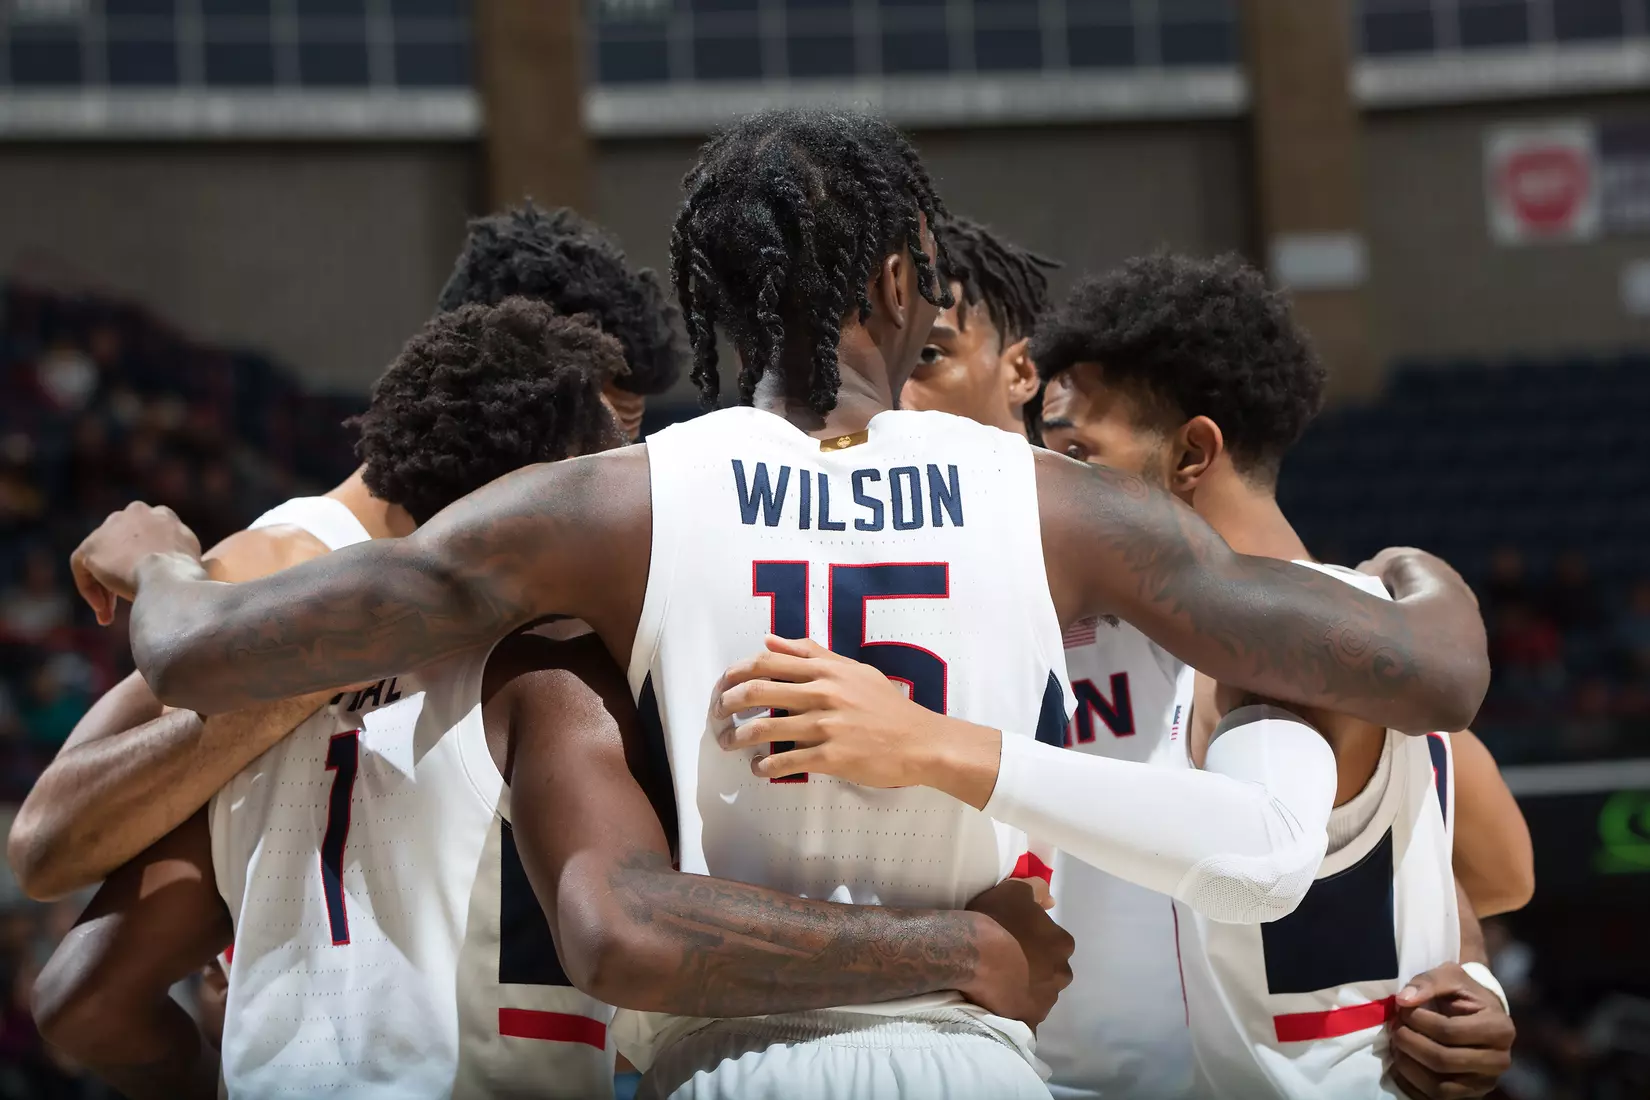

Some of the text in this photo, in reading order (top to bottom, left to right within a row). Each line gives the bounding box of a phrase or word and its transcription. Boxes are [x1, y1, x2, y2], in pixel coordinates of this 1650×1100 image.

[731, 459, 964, 532] WILSON
[752, 560, 949, 788] 15
[1064, 671, 1136, 748] N
[321, 729, 360, 946] 1
